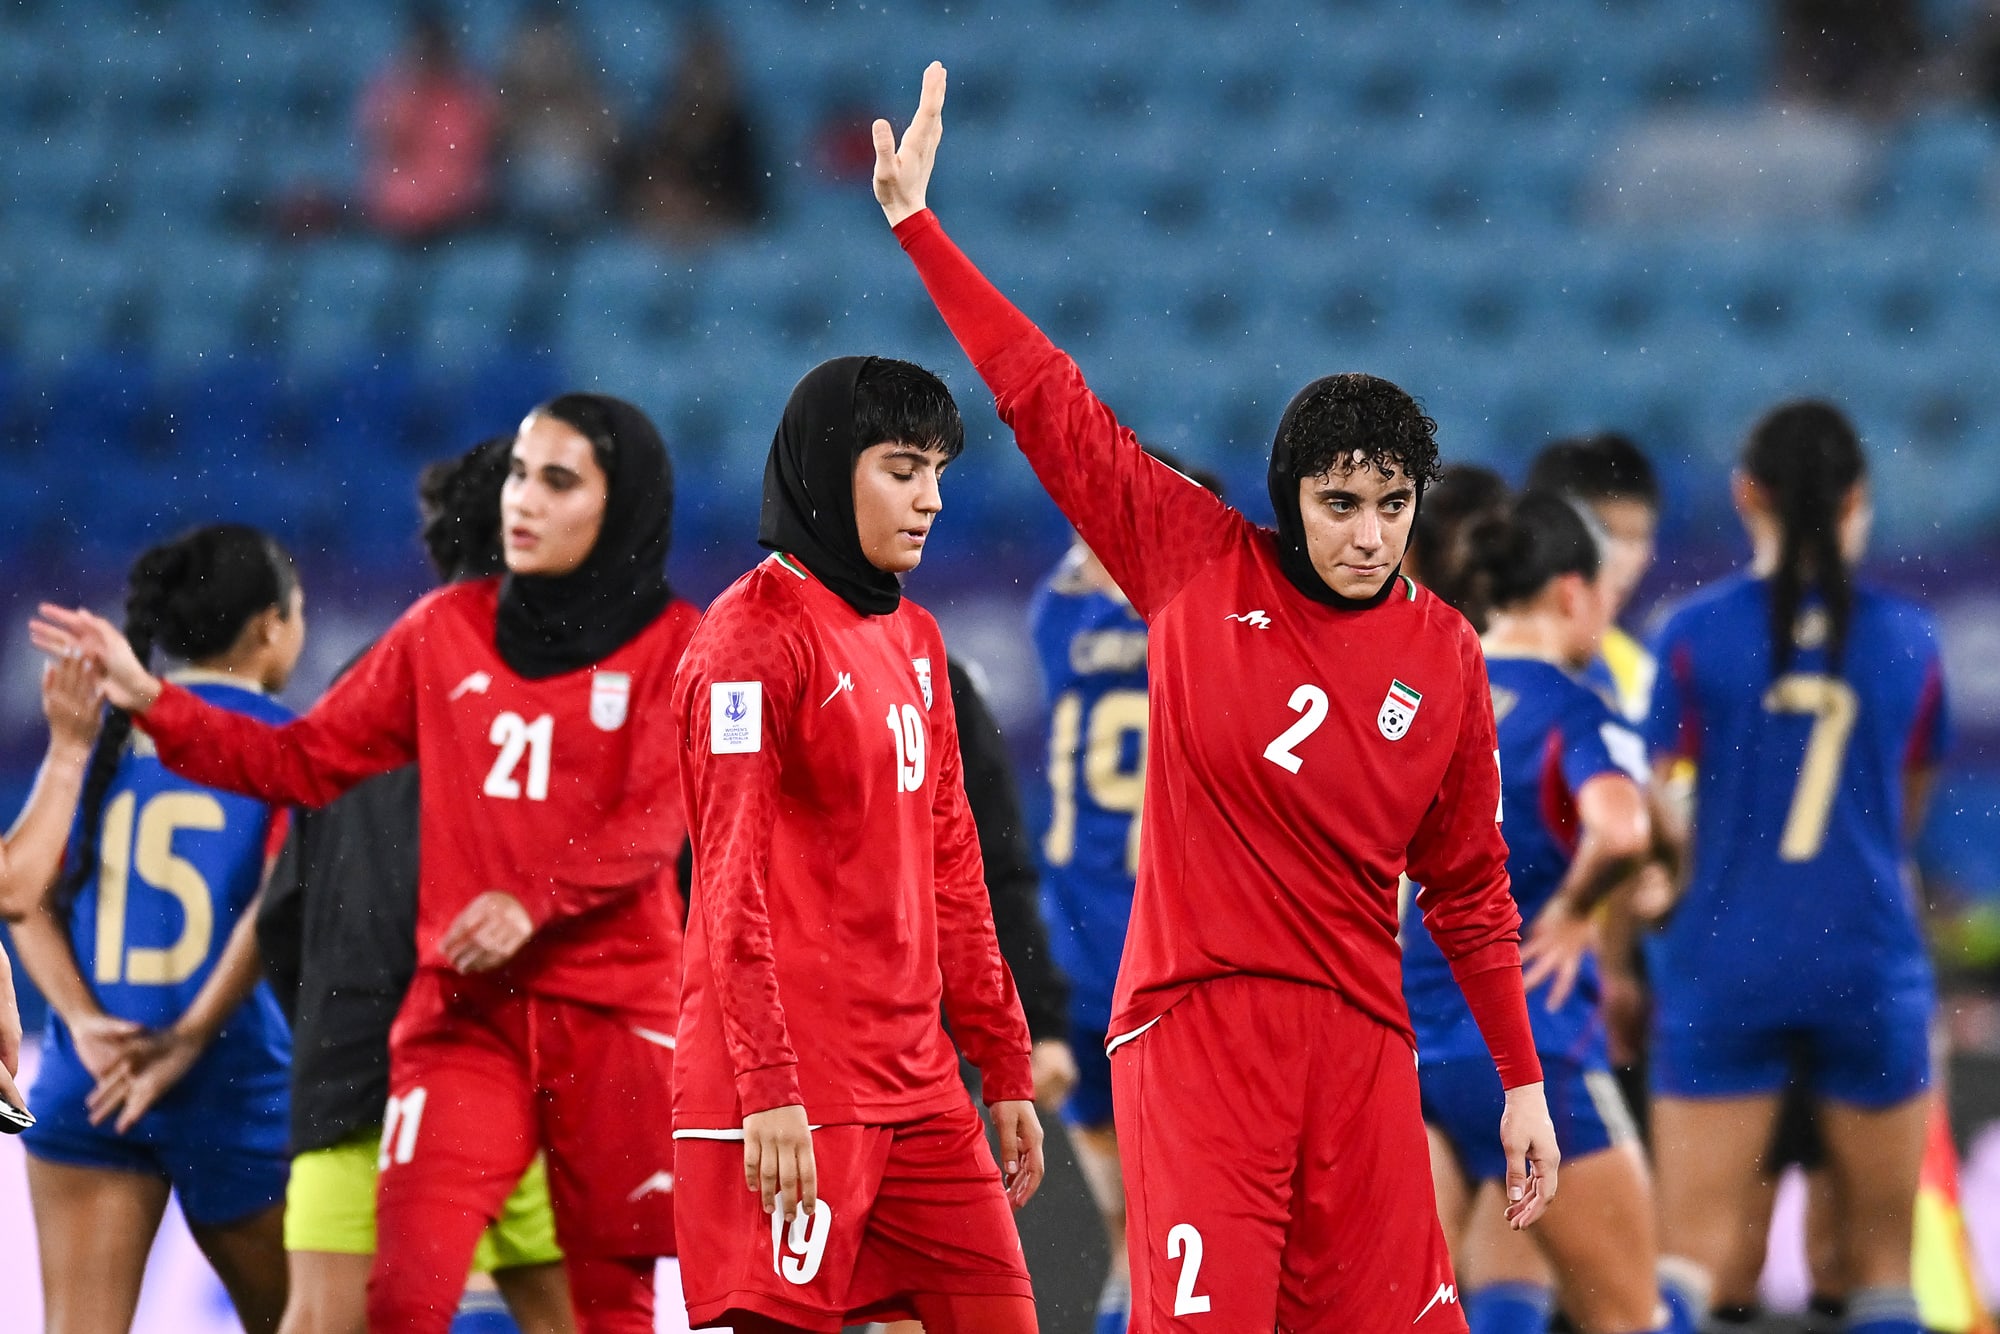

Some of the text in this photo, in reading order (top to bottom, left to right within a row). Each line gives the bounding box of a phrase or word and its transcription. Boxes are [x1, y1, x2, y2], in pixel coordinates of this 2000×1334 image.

[483, 711, 554, 801] 21
[886, 703, 926, 793] 19
[1262, 683, 1329, 775] 2
[1762, 674, 1858, 862] 7
[1044, 687, 1150, 880] 19
[94, 790, 226, 985] 15
[1167, 1223, 1211, 1317] 2
